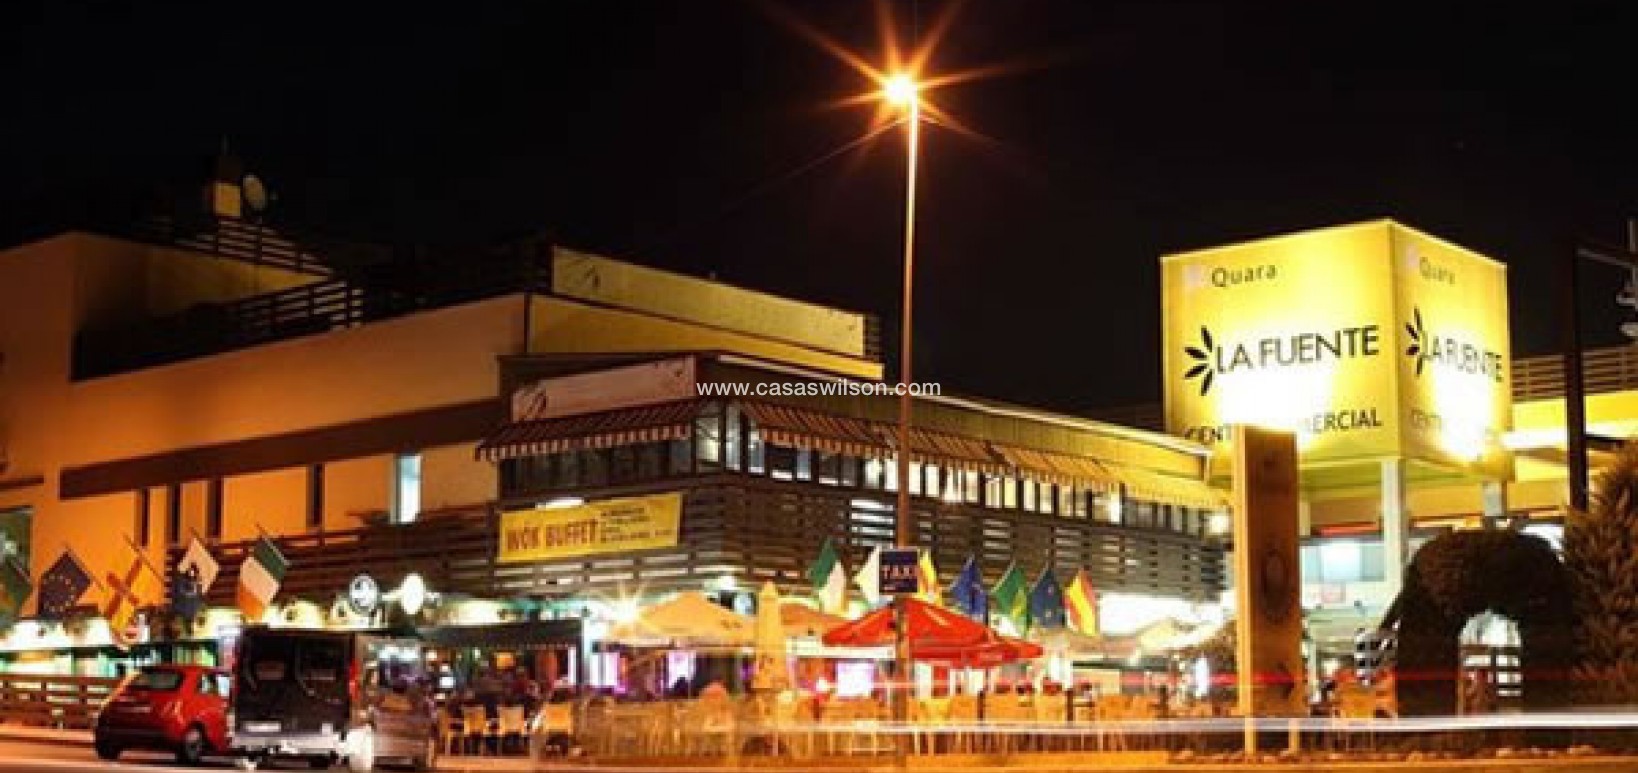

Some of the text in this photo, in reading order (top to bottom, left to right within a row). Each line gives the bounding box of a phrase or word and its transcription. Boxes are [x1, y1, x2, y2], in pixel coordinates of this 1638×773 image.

[1211, 264, 1277, 288] Quara
[1216, 324, 1380, 374] LA FUENTE
[506, 525, 539, 551] WOK
[545, 519, 598, 547] BUFFET
[880, 564, 920, 580] TAXI
